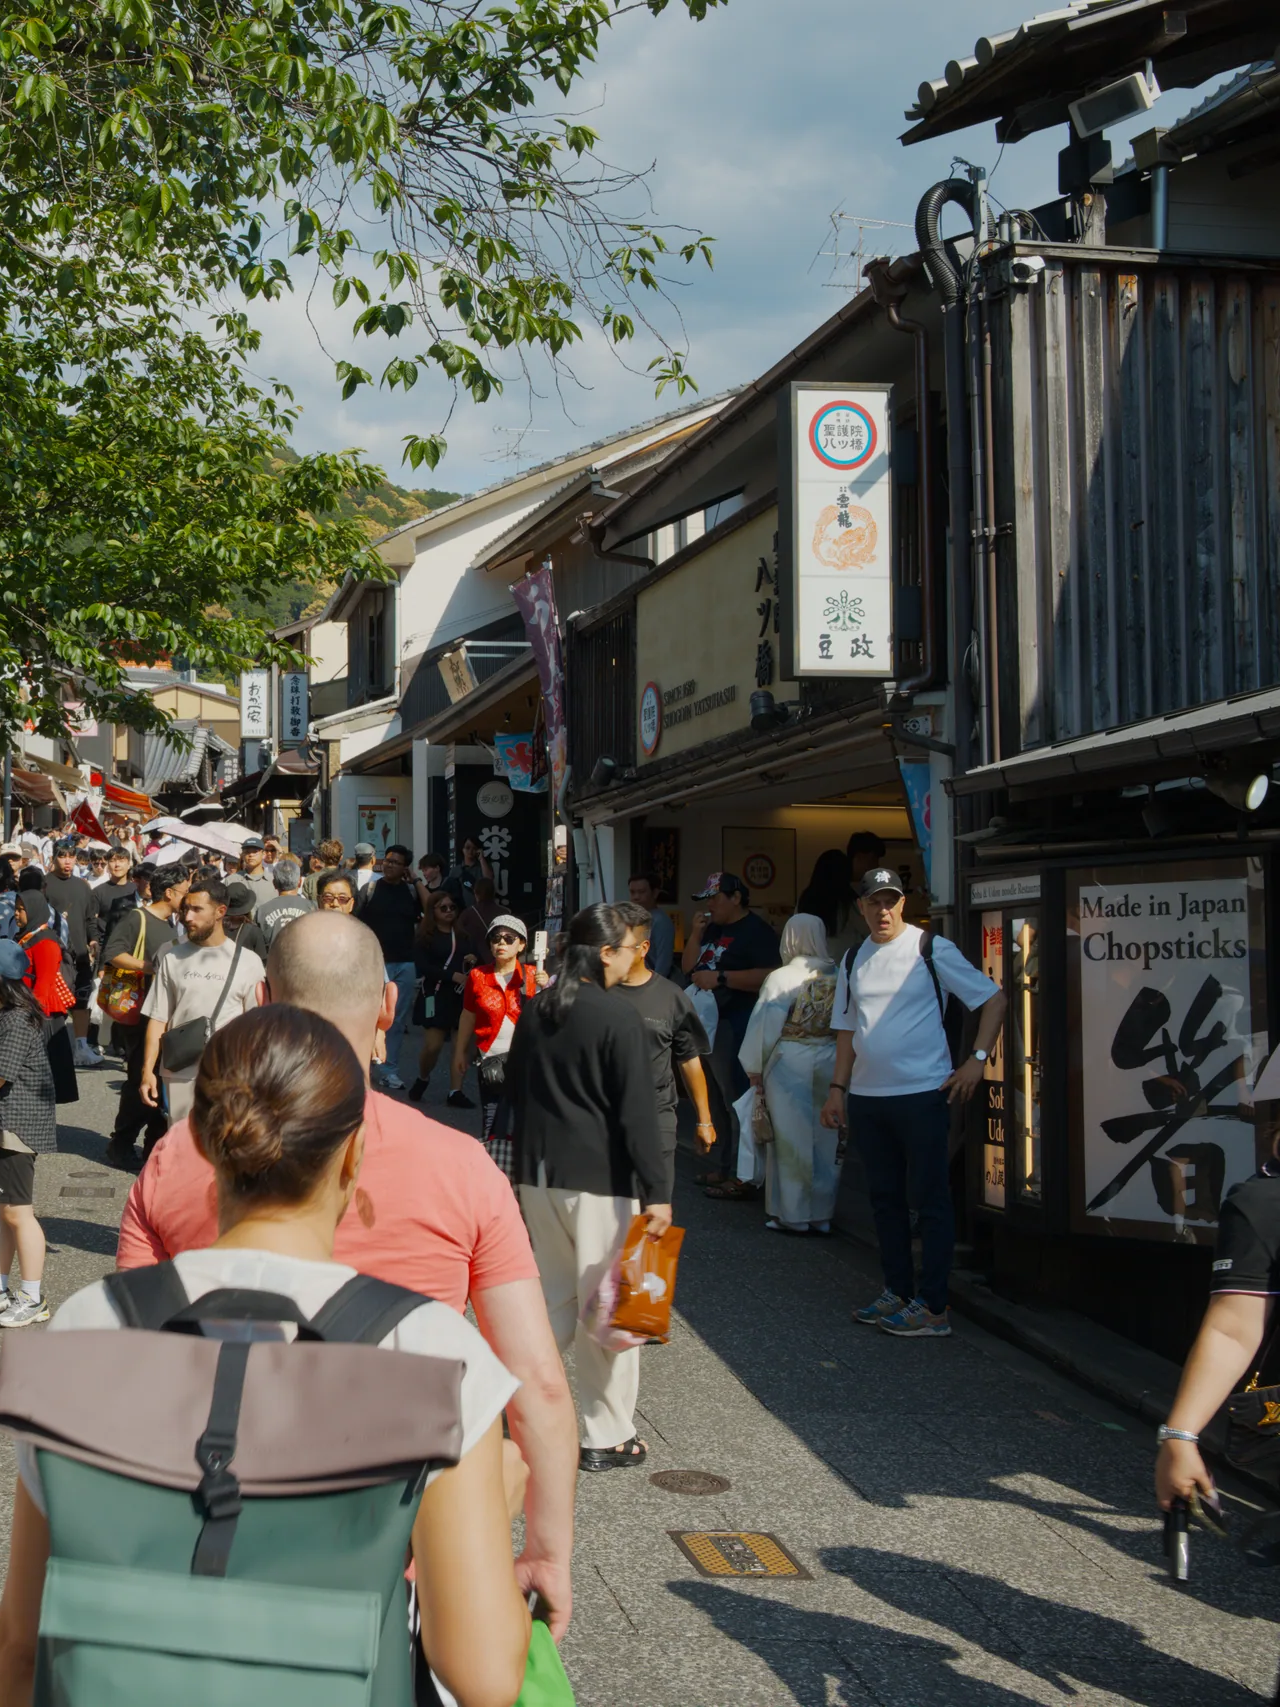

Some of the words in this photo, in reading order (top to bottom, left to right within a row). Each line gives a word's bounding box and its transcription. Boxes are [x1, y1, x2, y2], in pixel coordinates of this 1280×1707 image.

[823, 424, 864, 437] 聖護院
[836, 493, 852, 528] 雲龍
[818, 633, 876, 660] 豆政
[1082, 896, 1142, 919] Made
[1149, 896, 1171, 917] in
[1177, 892, 1246, 923] Japan
[1084, 928, 1247, 970] Chopsticks
